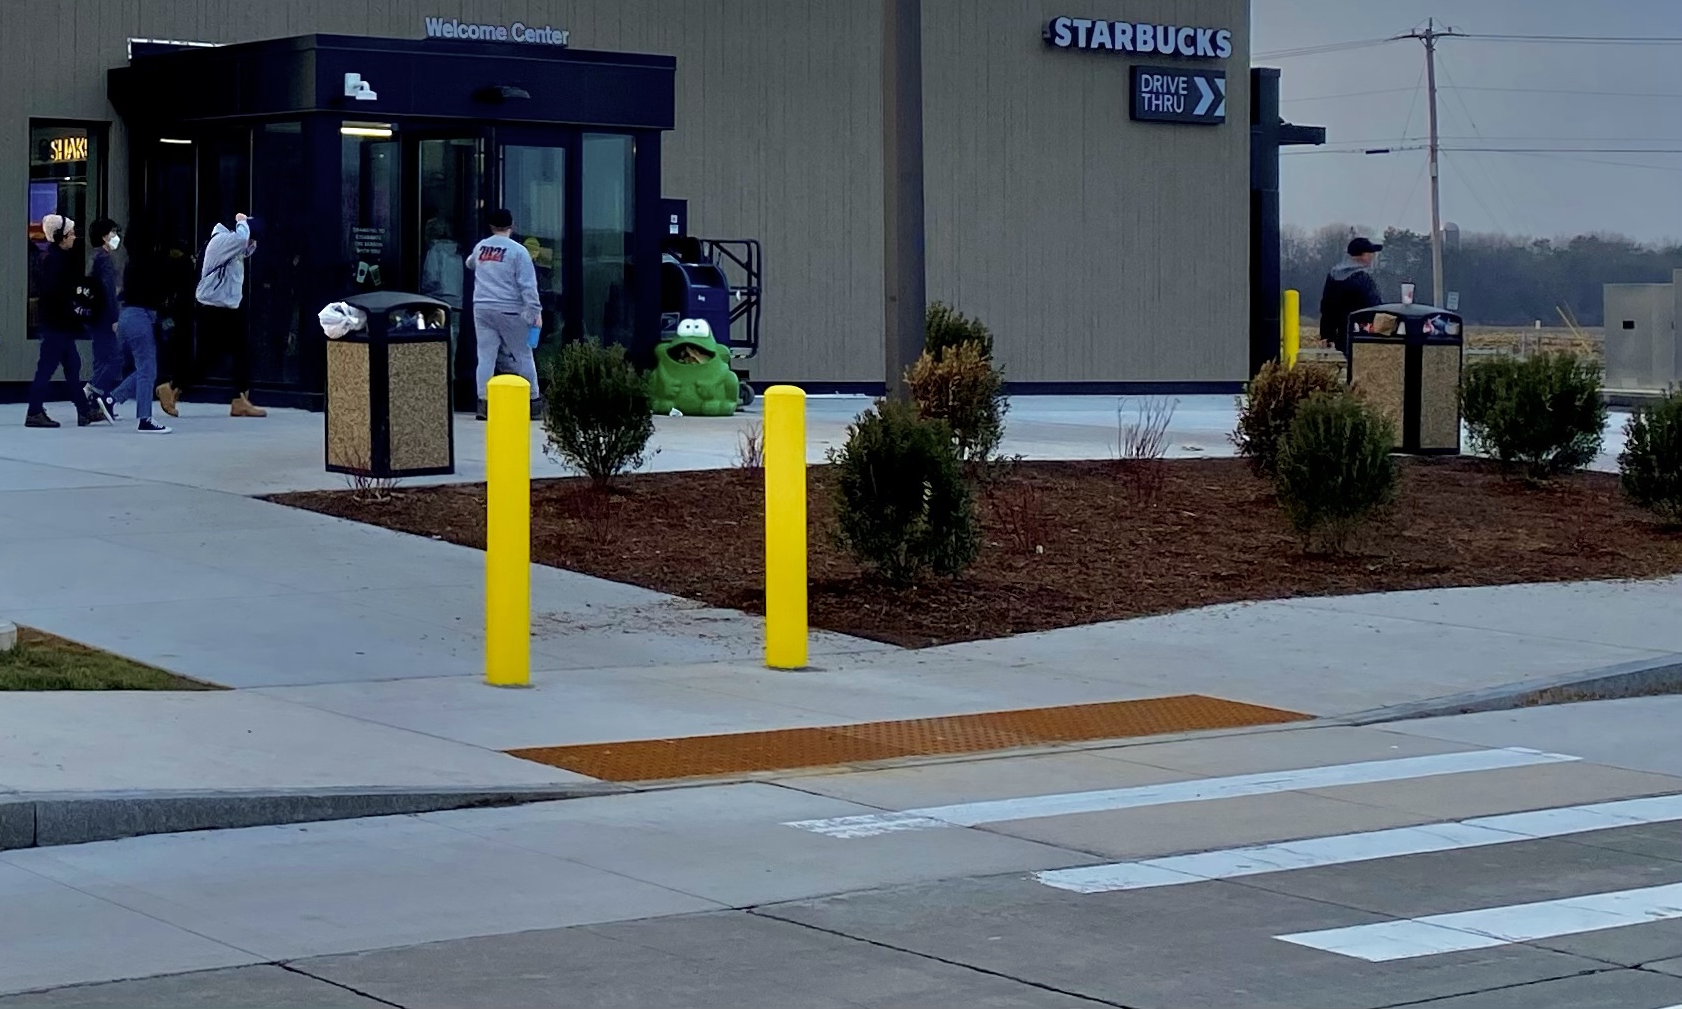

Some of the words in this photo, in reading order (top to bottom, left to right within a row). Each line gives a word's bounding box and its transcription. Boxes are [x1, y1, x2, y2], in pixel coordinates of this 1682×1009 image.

[425, 16, 508, 41] Welcome
[511, 22, 570, 45] Center
[1054, 16, 1233, 59] STARBUCKS
[1140, 74, 1189, 95] DRIVE
[1141, 93, 1186, 113] THRU
